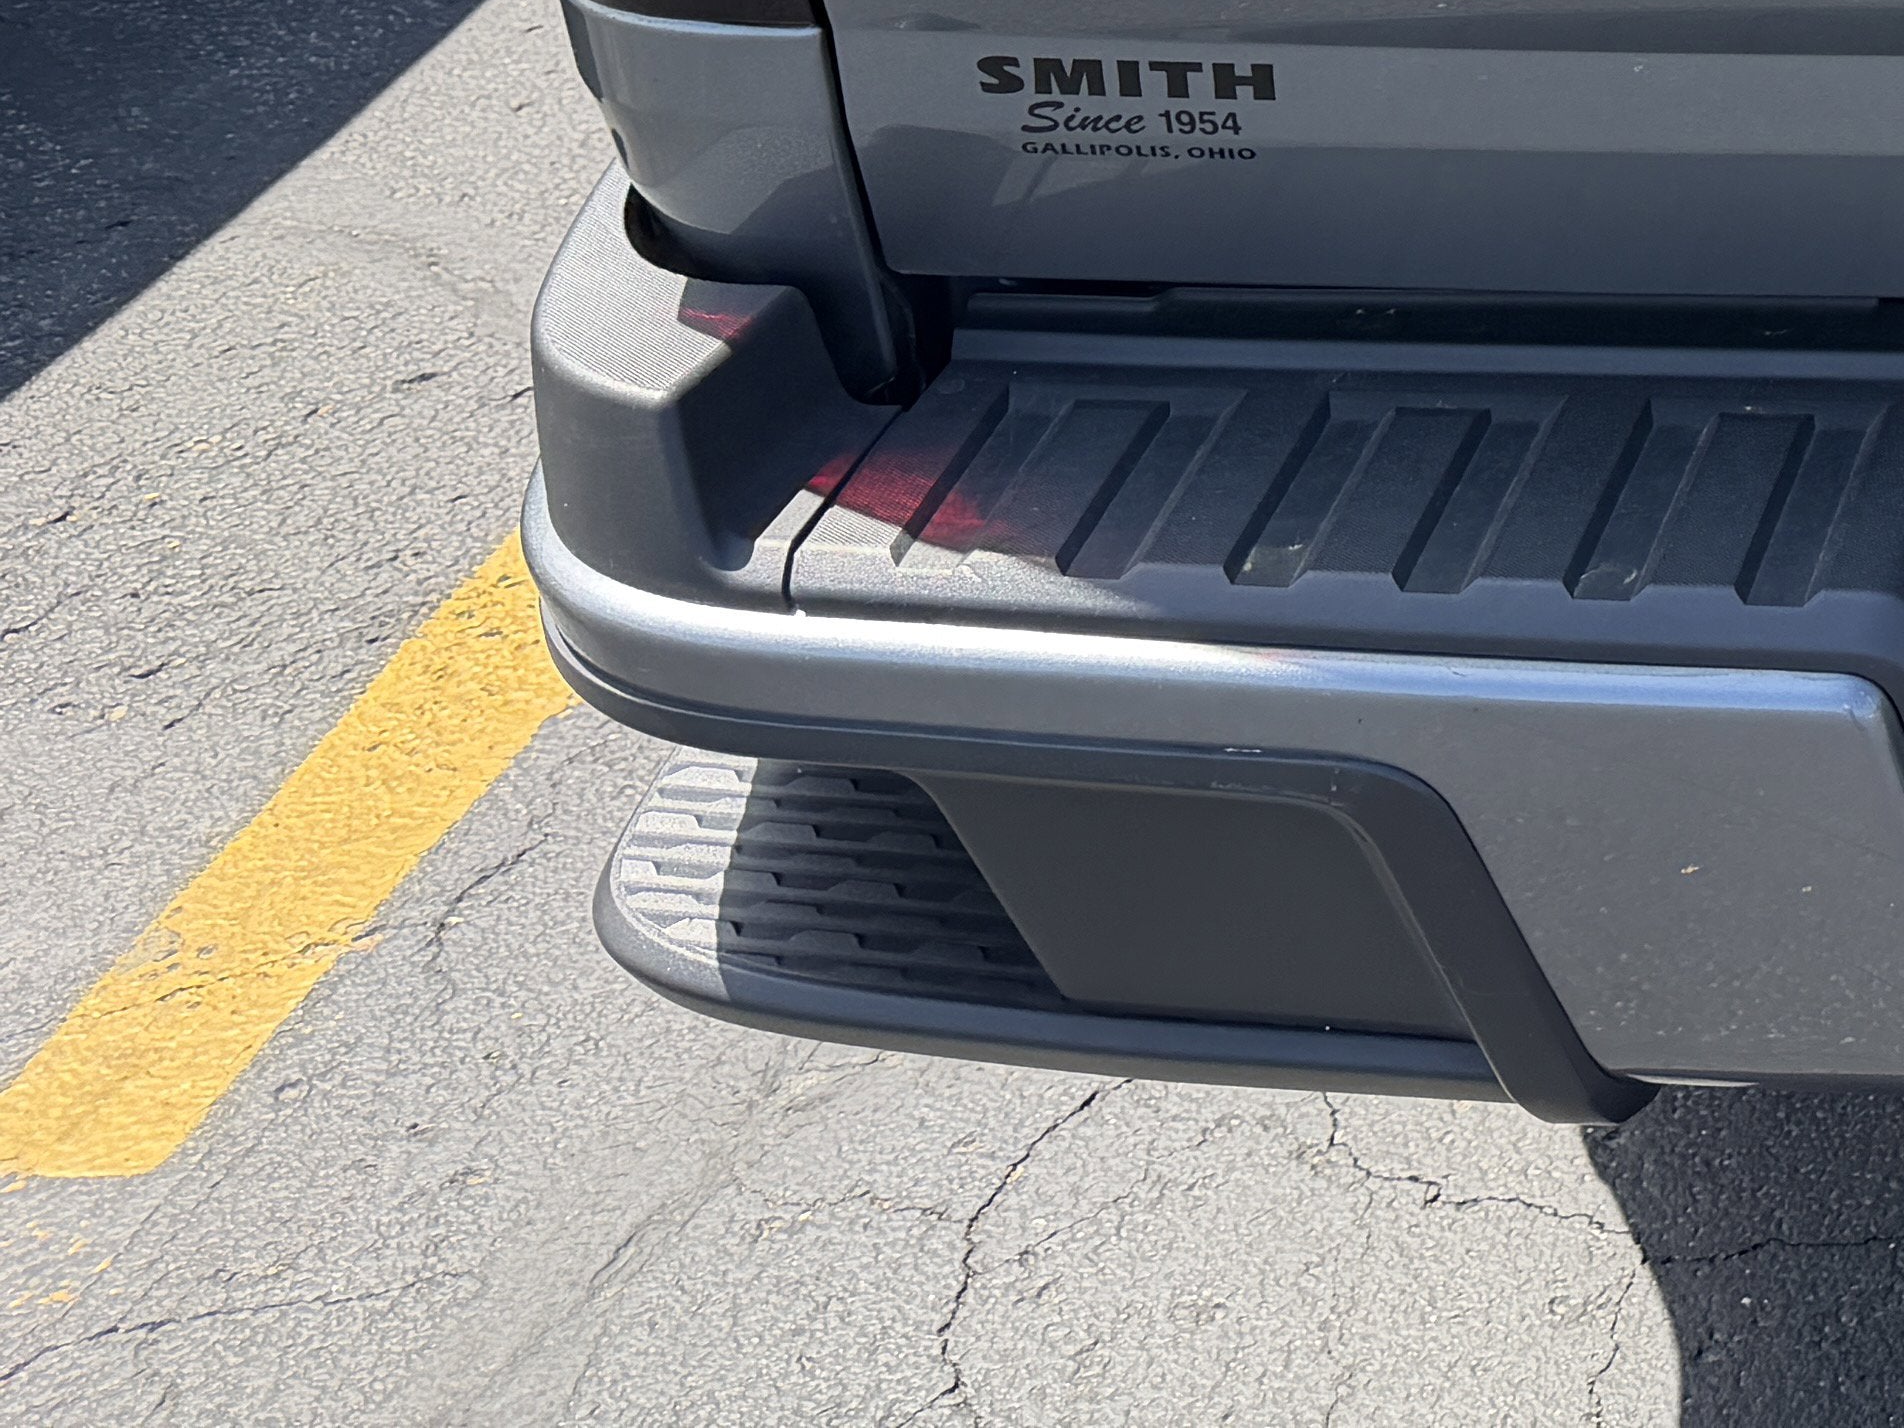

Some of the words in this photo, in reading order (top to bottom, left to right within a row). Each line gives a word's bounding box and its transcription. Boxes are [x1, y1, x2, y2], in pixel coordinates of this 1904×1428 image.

[976, 55, 1277, 101] SMITH
[1020, 99, 1146, 134] Since
[1157, 109, 1243, 136] 1954
[1020, 141, 1180, 160] GALLIPOLIS,
[1186, 146, 1258, 160] OHIO
